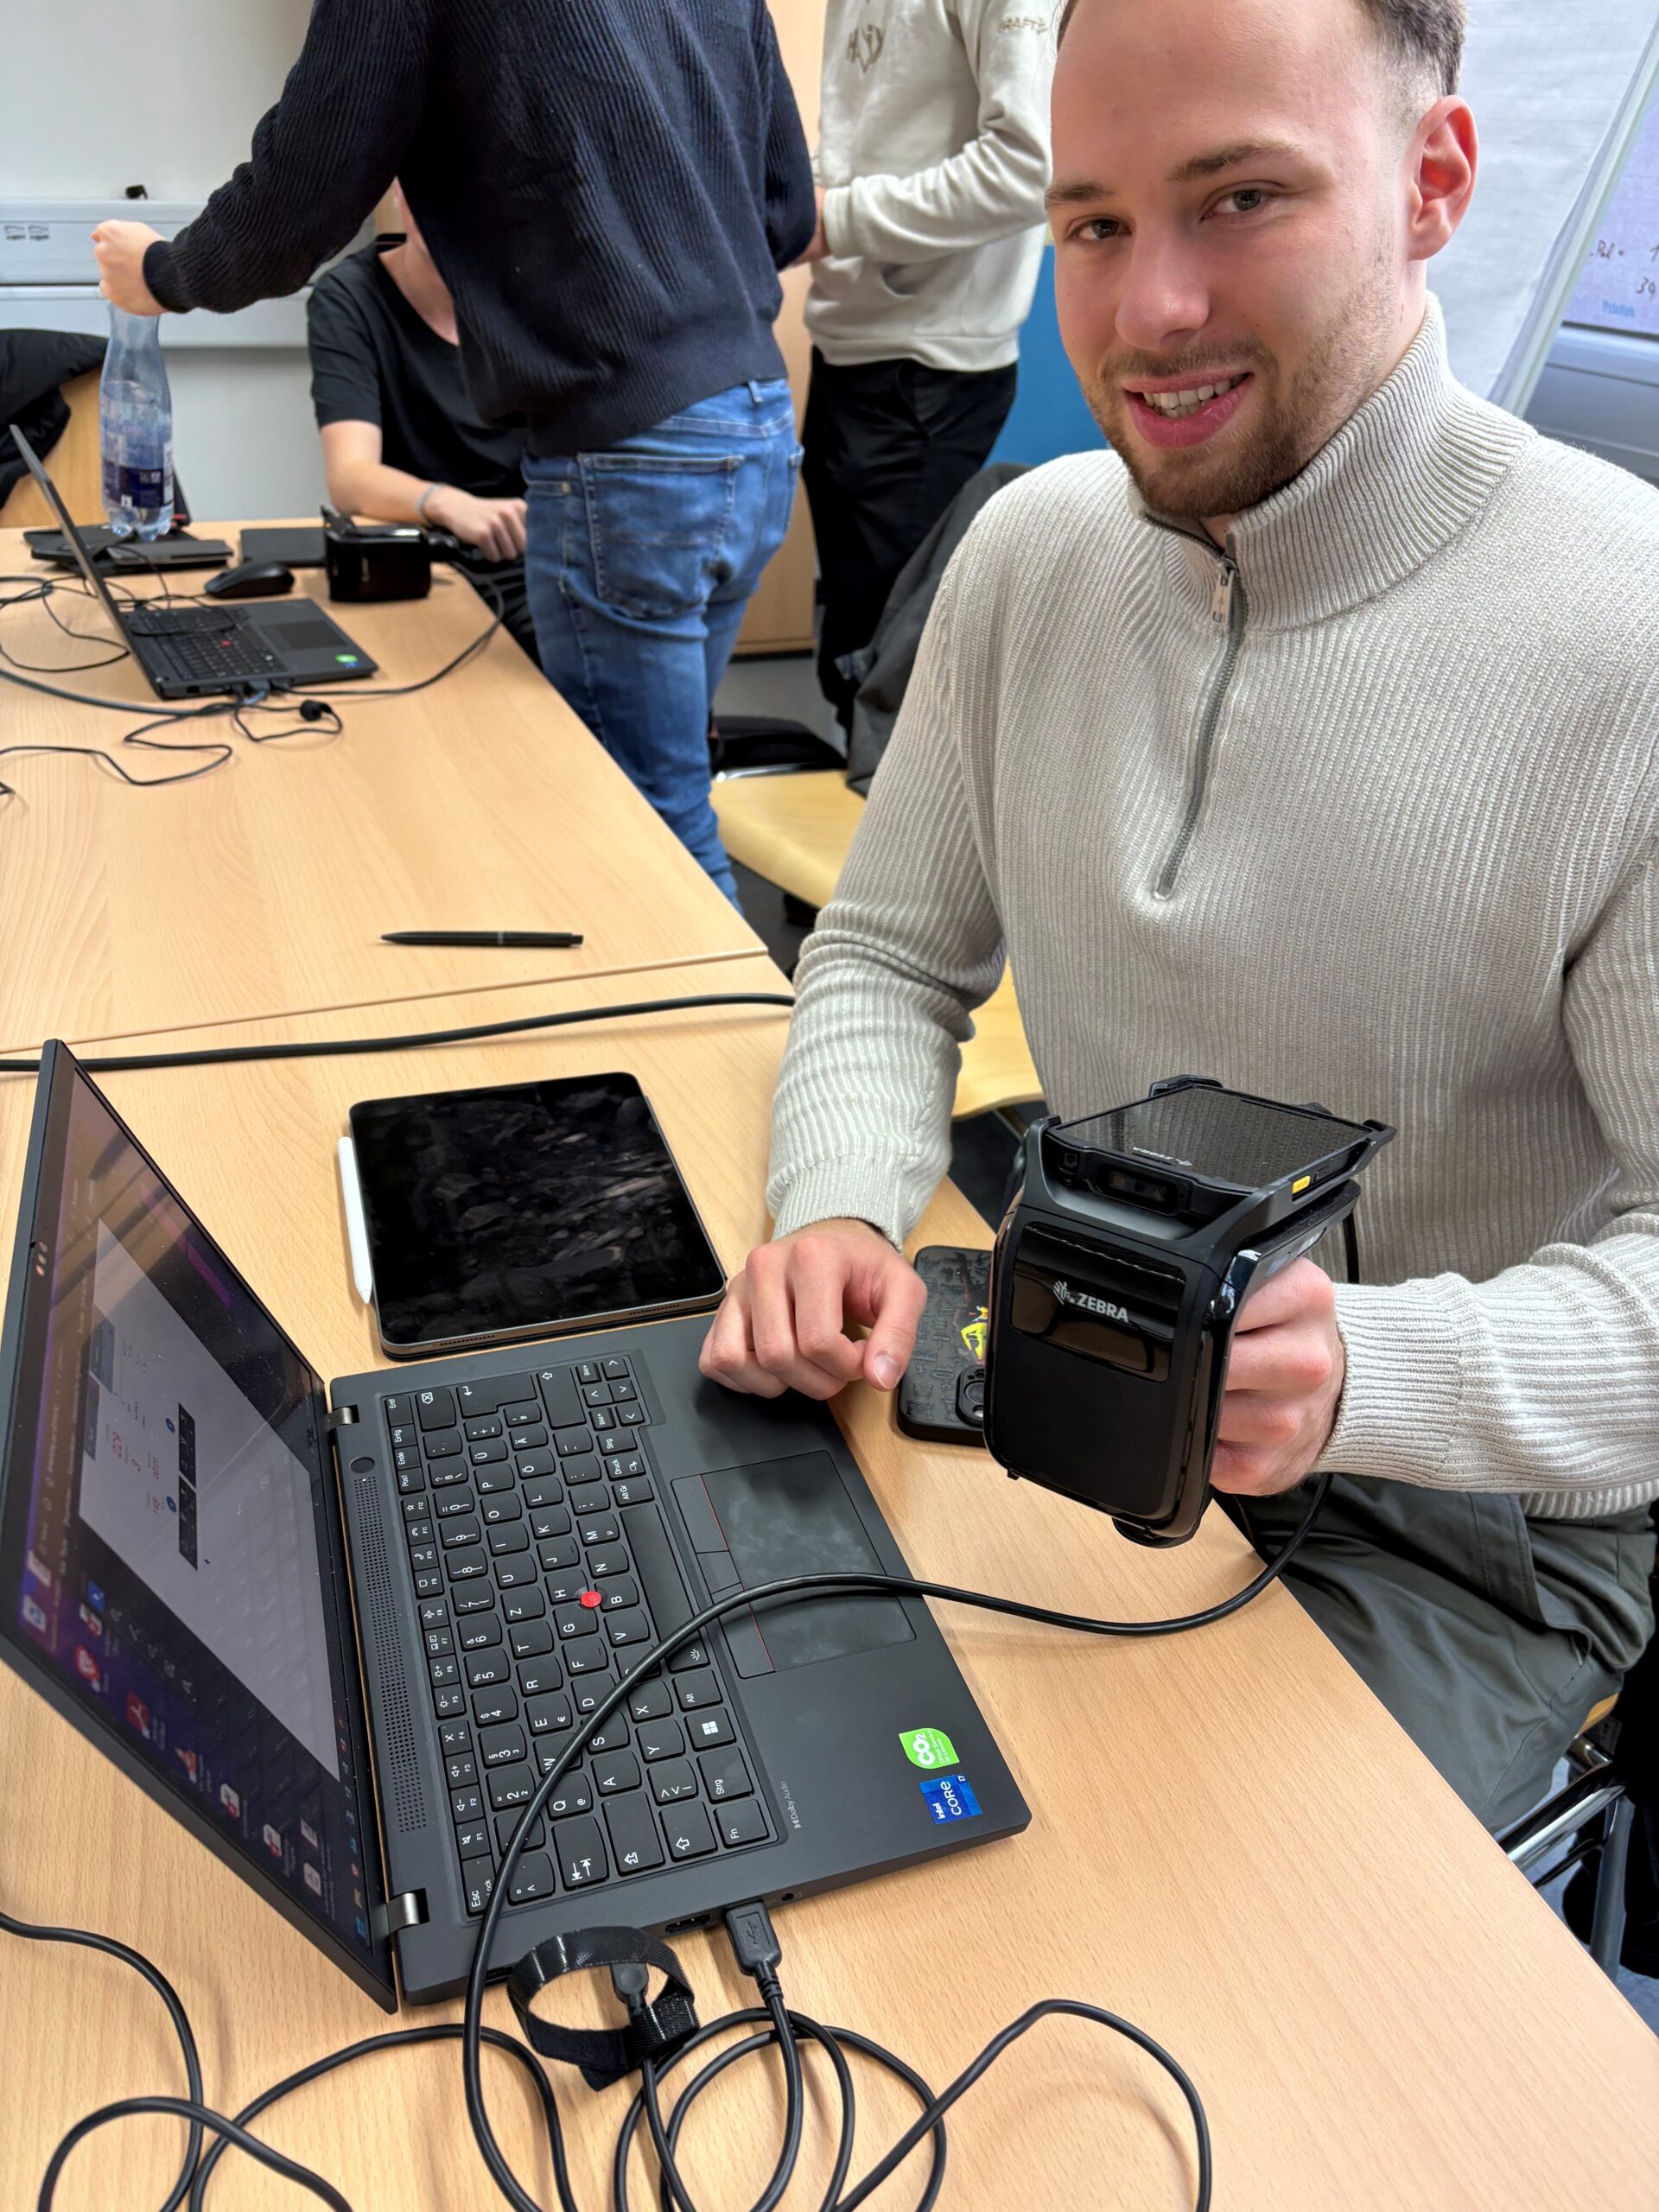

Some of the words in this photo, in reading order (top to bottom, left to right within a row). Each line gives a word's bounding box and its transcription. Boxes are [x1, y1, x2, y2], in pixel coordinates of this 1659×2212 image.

[1077, 1292, 1129, 1323] ZEBRA
[606, 1438, 614, 1450] Strg
[397, 1452, 406, 1465] Ende
[521, 1465, 535, 1473] Ö
[611, 1459, 623, 1475] Druck
[400, 1474, 409, 1487] Pos1
[531, 1494, 543, 1503] L
[487, 1510, 500, 1519] O
[537, 1524, 550, 1534] K
[585, 1530, 599, 1541] M
[594, 1562, 607, 1573] N
[501, 1574, 514, 1583] U
[554, 1589, 567, 1599] H
[610, 1595, 623, 1605] B
[509, 1607, 523, 1617] Z
[563, 1623, 575, 1633] G
[614, 1632, 627, 1641] V
[517, 1644, 530, 1653] T
[525, 1679, 539, 1690] R
[582, 1697, 595, 1707] D
[685, 1693, 696, 1703] Alt
[635, 1705, 650, 1715] X
[534, 1718, 548, 1728] E
[458, 1731, 466, 1740] F4
[592, 1736, 606, 1746] S
[646, 1746, 660, 1756] Y
[463, 1764, 472, 1773] F3
[602, 1776, 617, 1786] A
[714, 1778, 725, 1796] Strg
[781, 1780, 791, 1800] Audio
[506, 1790, 520, 1800] 2
[469, 1797, 477, 1807] F2
[552, 1799, 567, 1812] Q
[787, 1800, 798, 1820] Dolby
[932, 1802, 946, 1820] intel
[475, 1832, 484, 1841] F1
[729, 1827, 740, 1840] Fn
[471, 1890, 481, 1908] Esc
